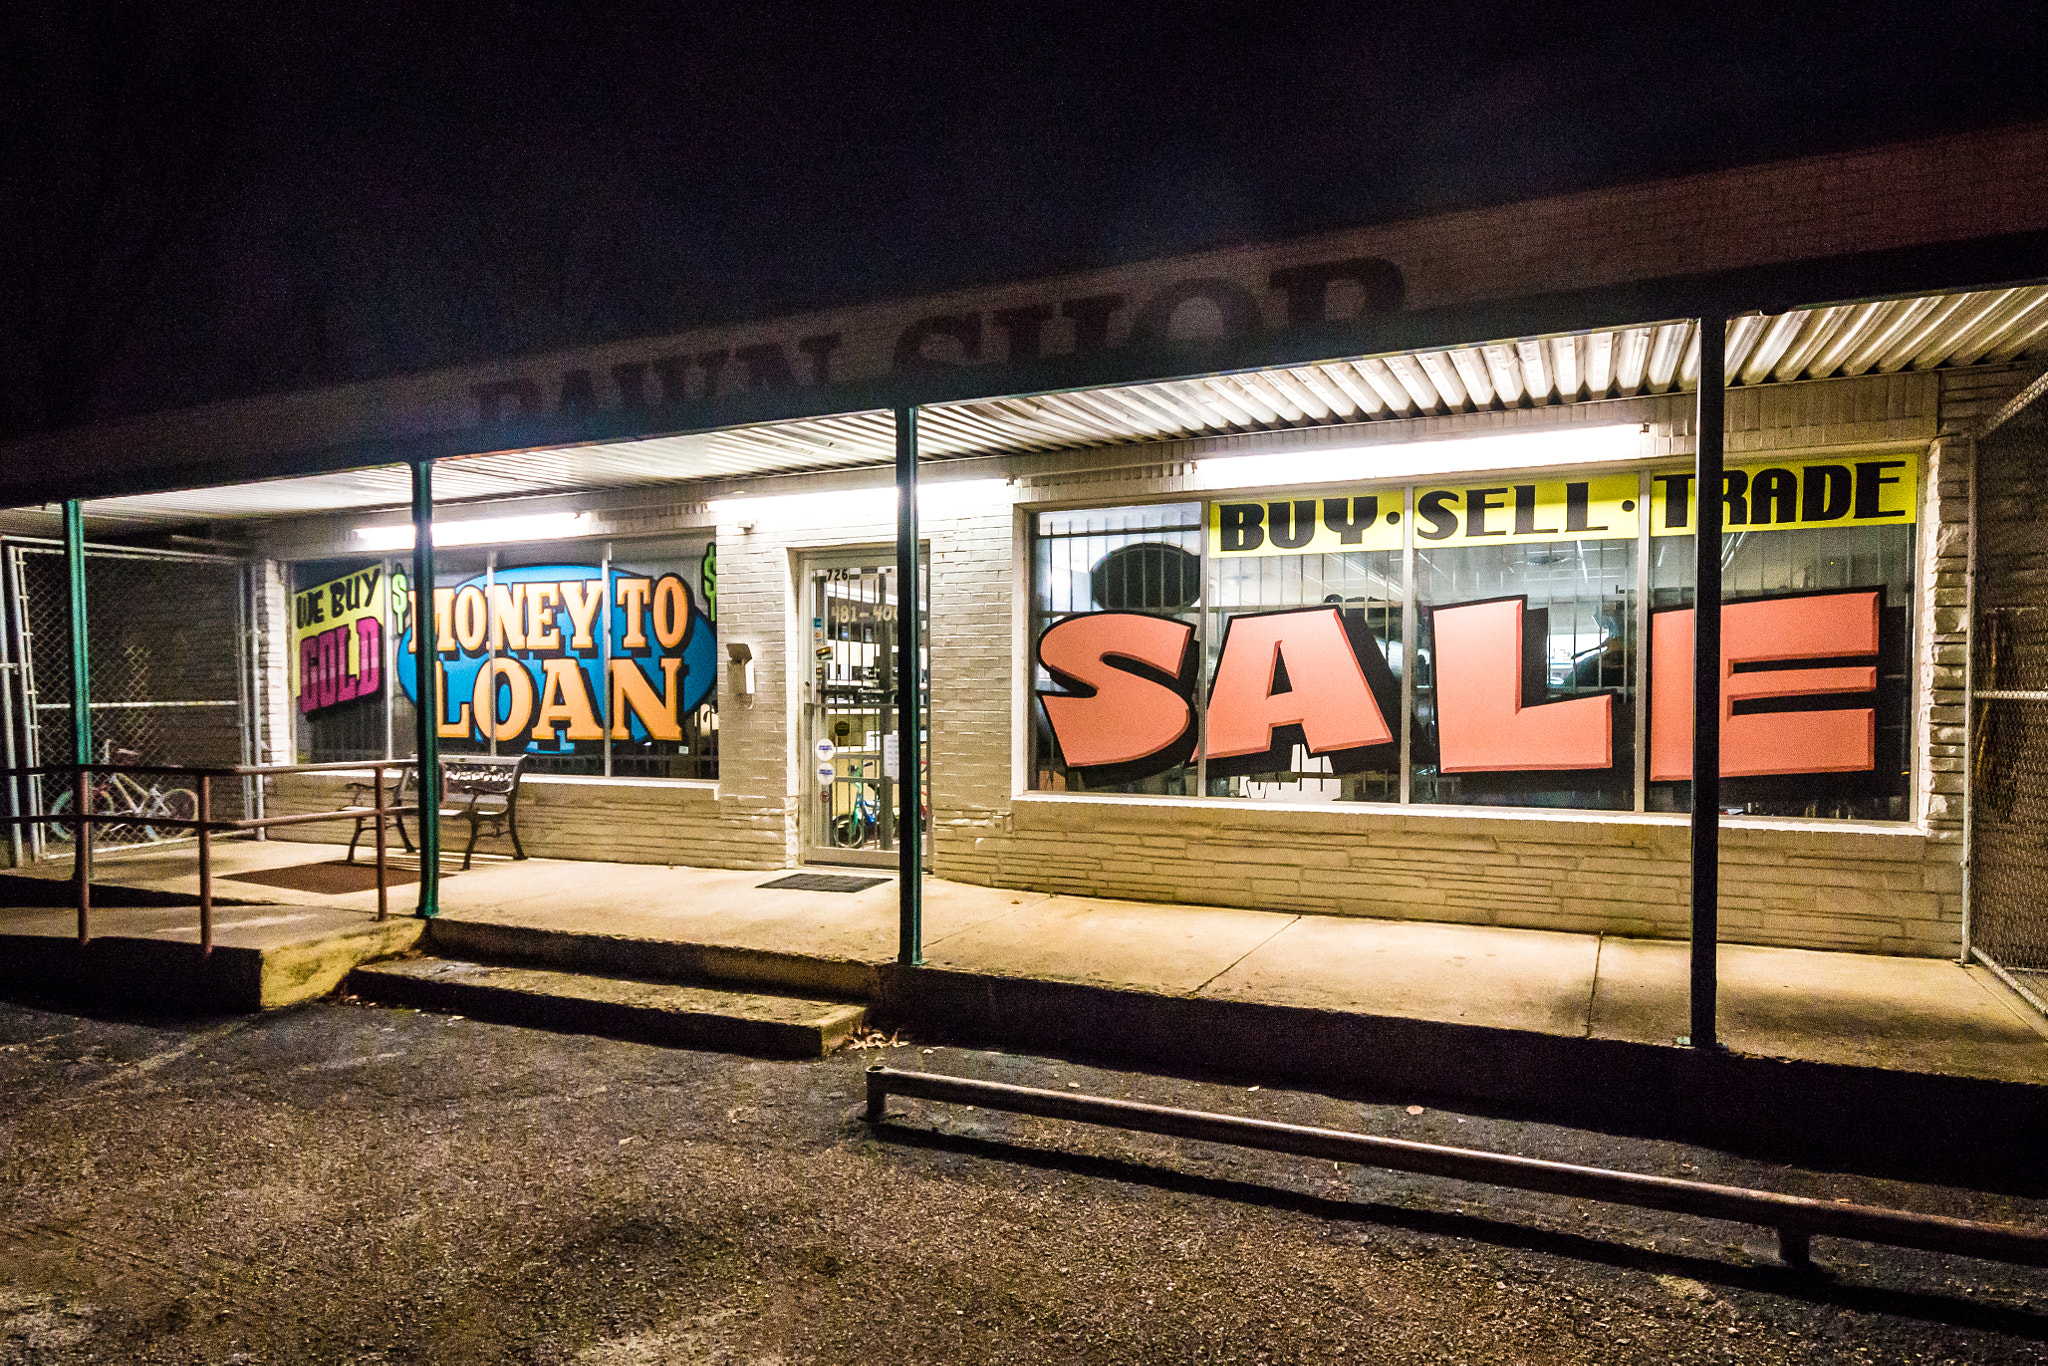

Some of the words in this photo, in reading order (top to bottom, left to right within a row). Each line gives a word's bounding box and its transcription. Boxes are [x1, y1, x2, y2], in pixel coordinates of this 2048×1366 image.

[1654, 461, 1906, 529] TRADE
[296, 591, 325, 630] WE
[330, 568, 381, 619] BUY
[616, 574, 690, 651] TO
[827, 568, 849, 582] 726
[301, 615, 382, 716] GOLD
[434, 656, 684, 741] LOAN
[1038, 587, 1882, 781] SALE
